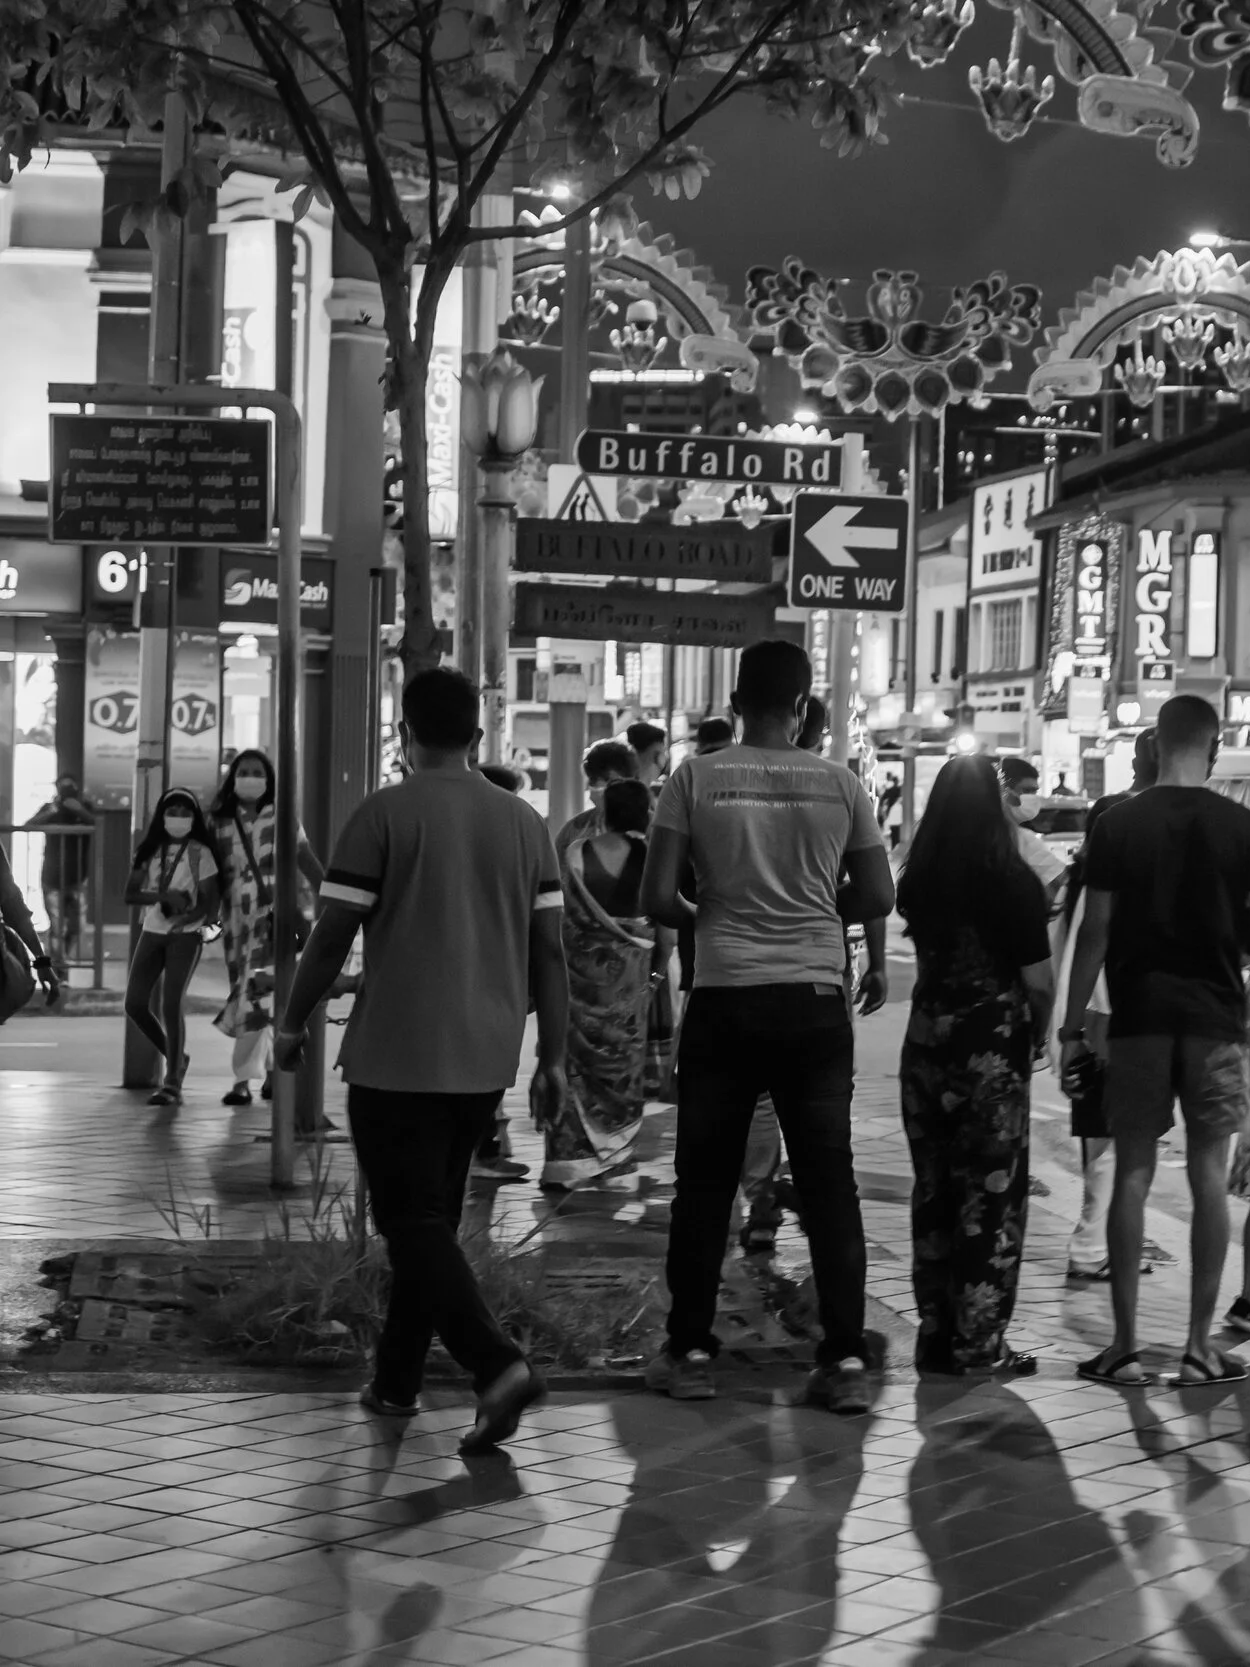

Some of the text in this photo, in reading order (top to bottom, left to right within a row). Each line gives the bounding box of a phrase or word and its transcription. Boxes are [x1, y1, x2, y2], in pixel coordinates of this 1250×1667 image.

[428, 352, 453, 486] Maxi-Cash
[599, 437, 831, 482] Buffalo Rd
[799, 574, 896, 602] ONE WAY
[1135, 530, 1172, 657] MGR
